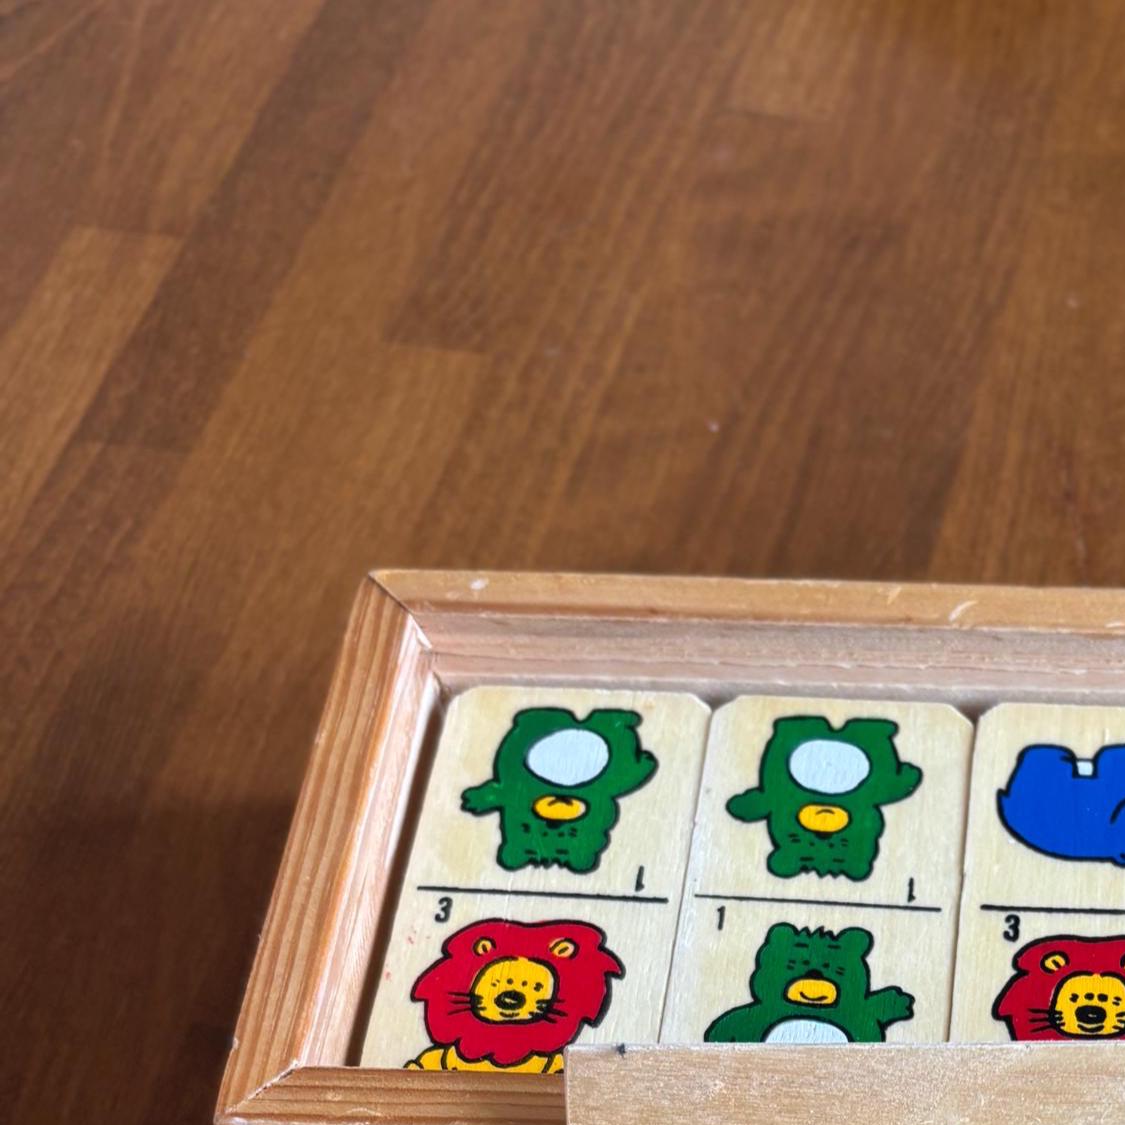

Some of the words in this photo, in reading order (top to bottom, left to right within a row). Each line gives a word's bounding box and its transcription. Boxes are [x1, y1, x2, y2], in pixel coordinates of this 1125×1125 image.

[634, 865, 645, 892] 1
[907, 877, 916, 903] 1
[434, 896, 453, 923] 3
[717, 905, 726, 931] 1
[1002, 914, 1021, 943] 3
